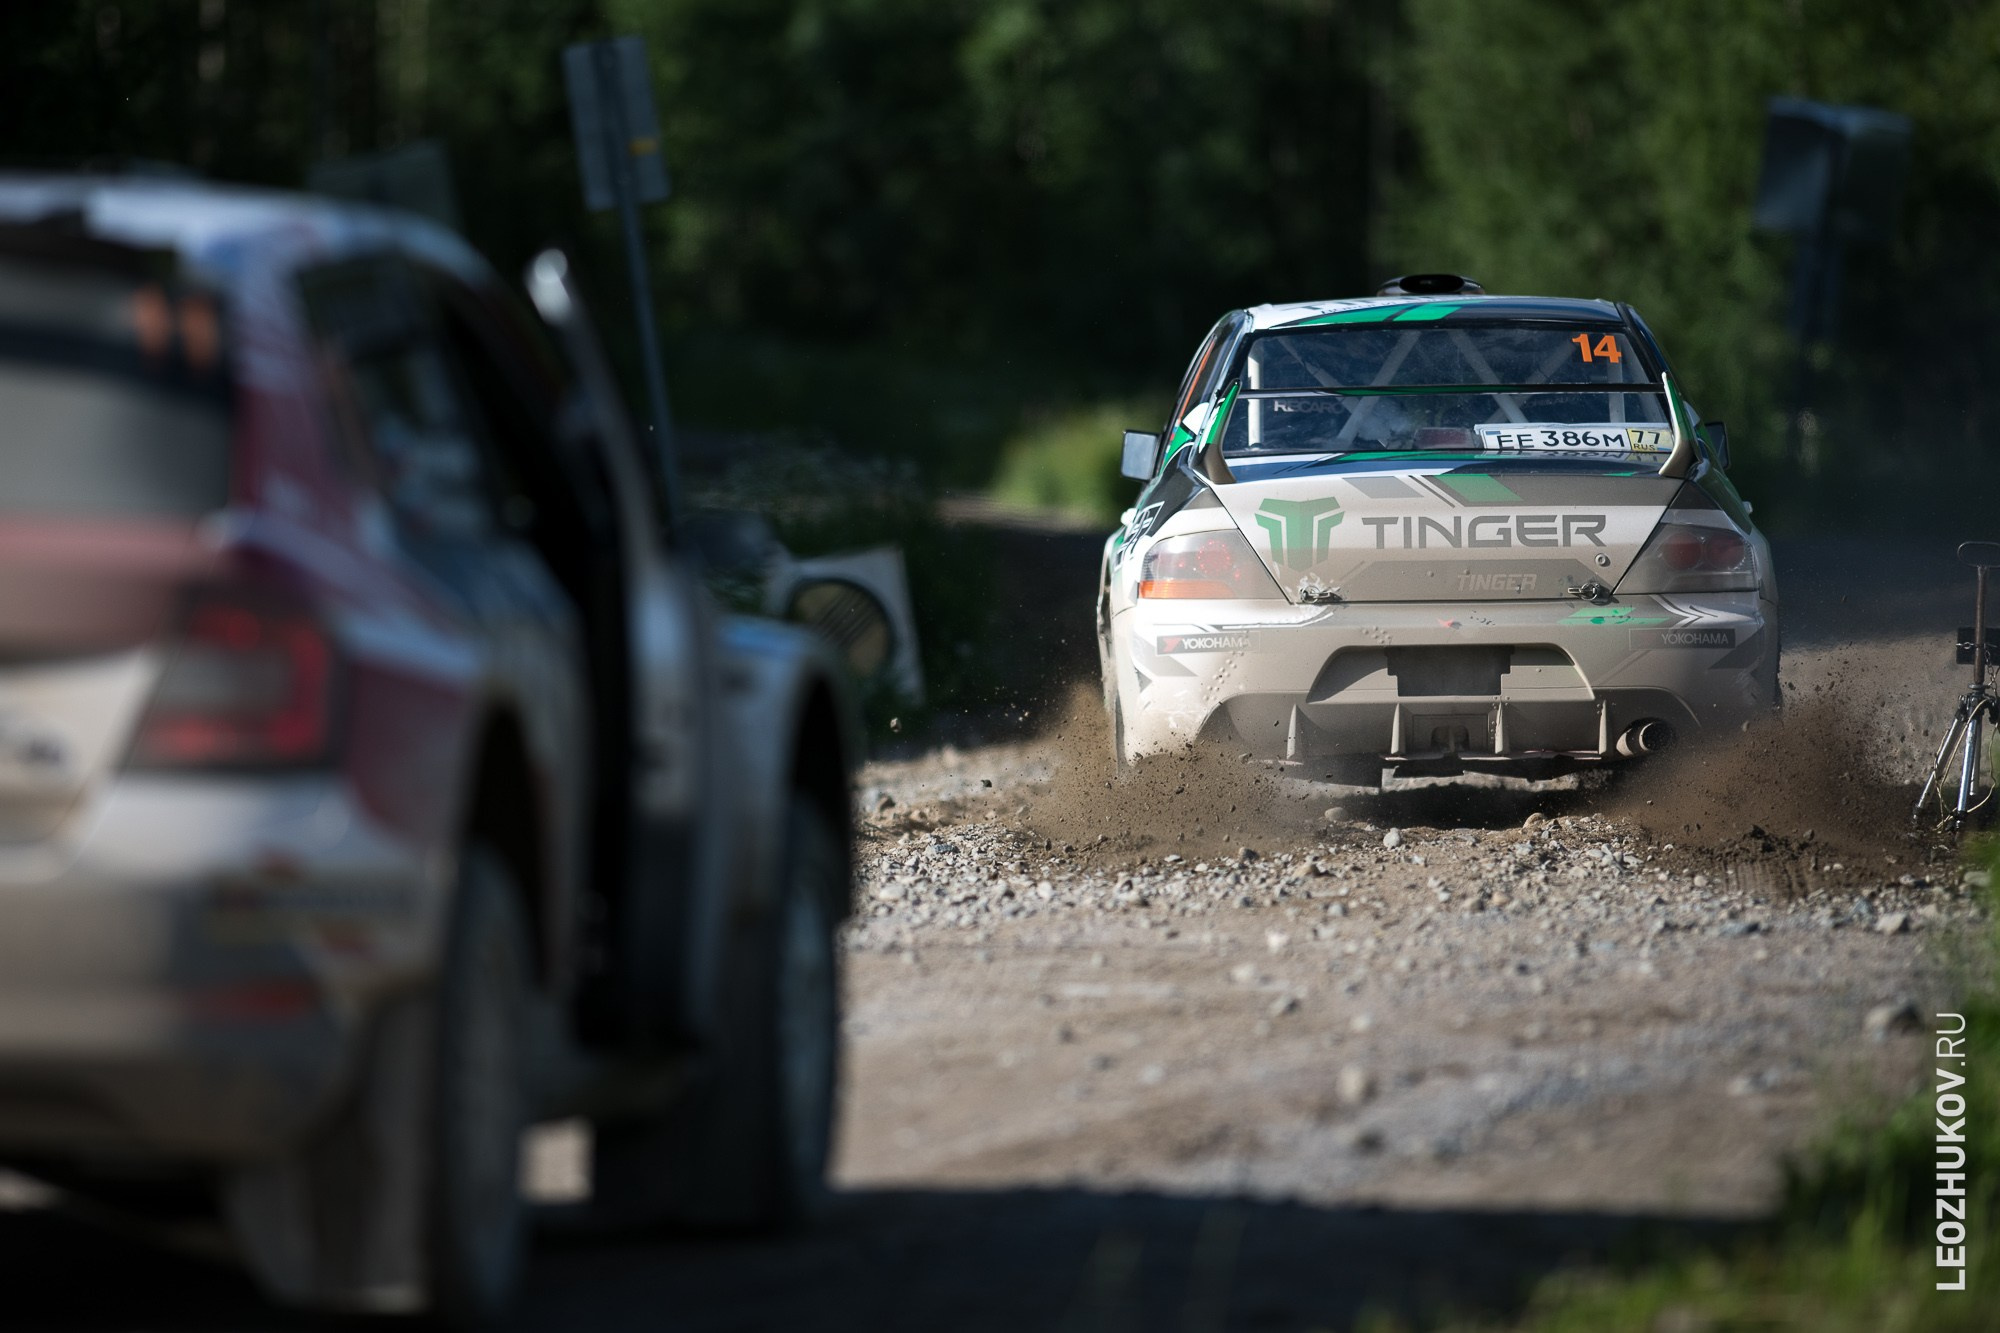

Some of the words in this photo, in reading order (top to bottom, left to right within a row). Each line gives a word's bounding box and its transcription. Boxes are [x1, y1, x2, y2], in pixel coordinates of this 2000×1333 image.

[1572, 333, 1622, 363] 14
[1273, 400, 1344, 415] RECARO
[1631, 430, 1661, 445] 77
[1633, 443, 1656, 451] RUS
[1361, 514, 1607, 549] TINGER
[1457, 573, 1537, 592] TINGER
[1182, 636, 1252, 650] YOKOHAMA
[1661, 632, 1729, 645] YOKOHAMA
